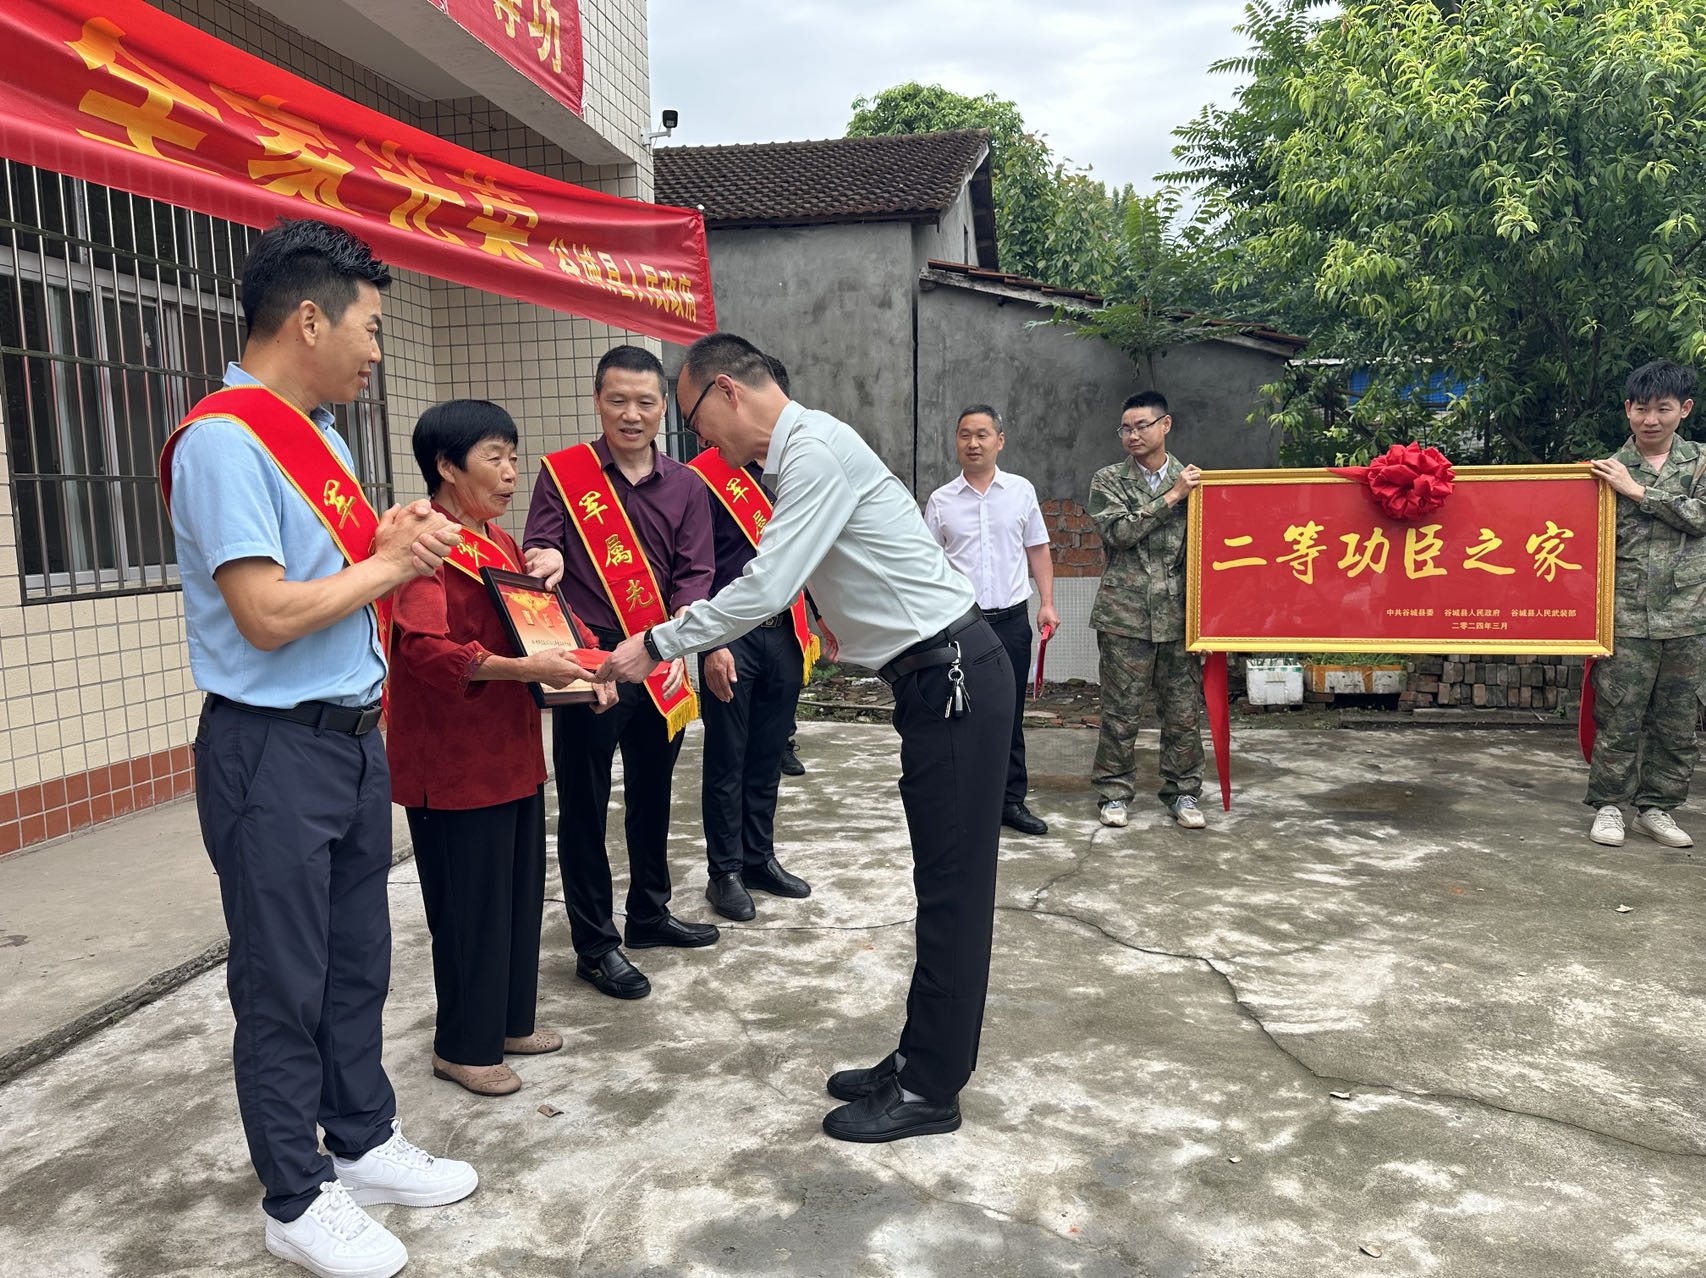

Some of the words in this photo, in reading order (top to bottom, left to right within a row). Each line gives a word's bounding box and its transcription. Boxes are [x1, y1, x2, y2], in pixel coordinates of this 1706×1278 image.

[578, 490, 656, 627] 军属光
[1212, 520, 1583, 585] 二等功臣之家
[1386, 608, 1434, 617] 中共谷城县委
[1444, 608, 1501, 617] 谷城县人民政府
[1511, 608, 1577, 617] 谷城县人民武装部
[1451, 621, 1508, 630] 二零二四年三月
